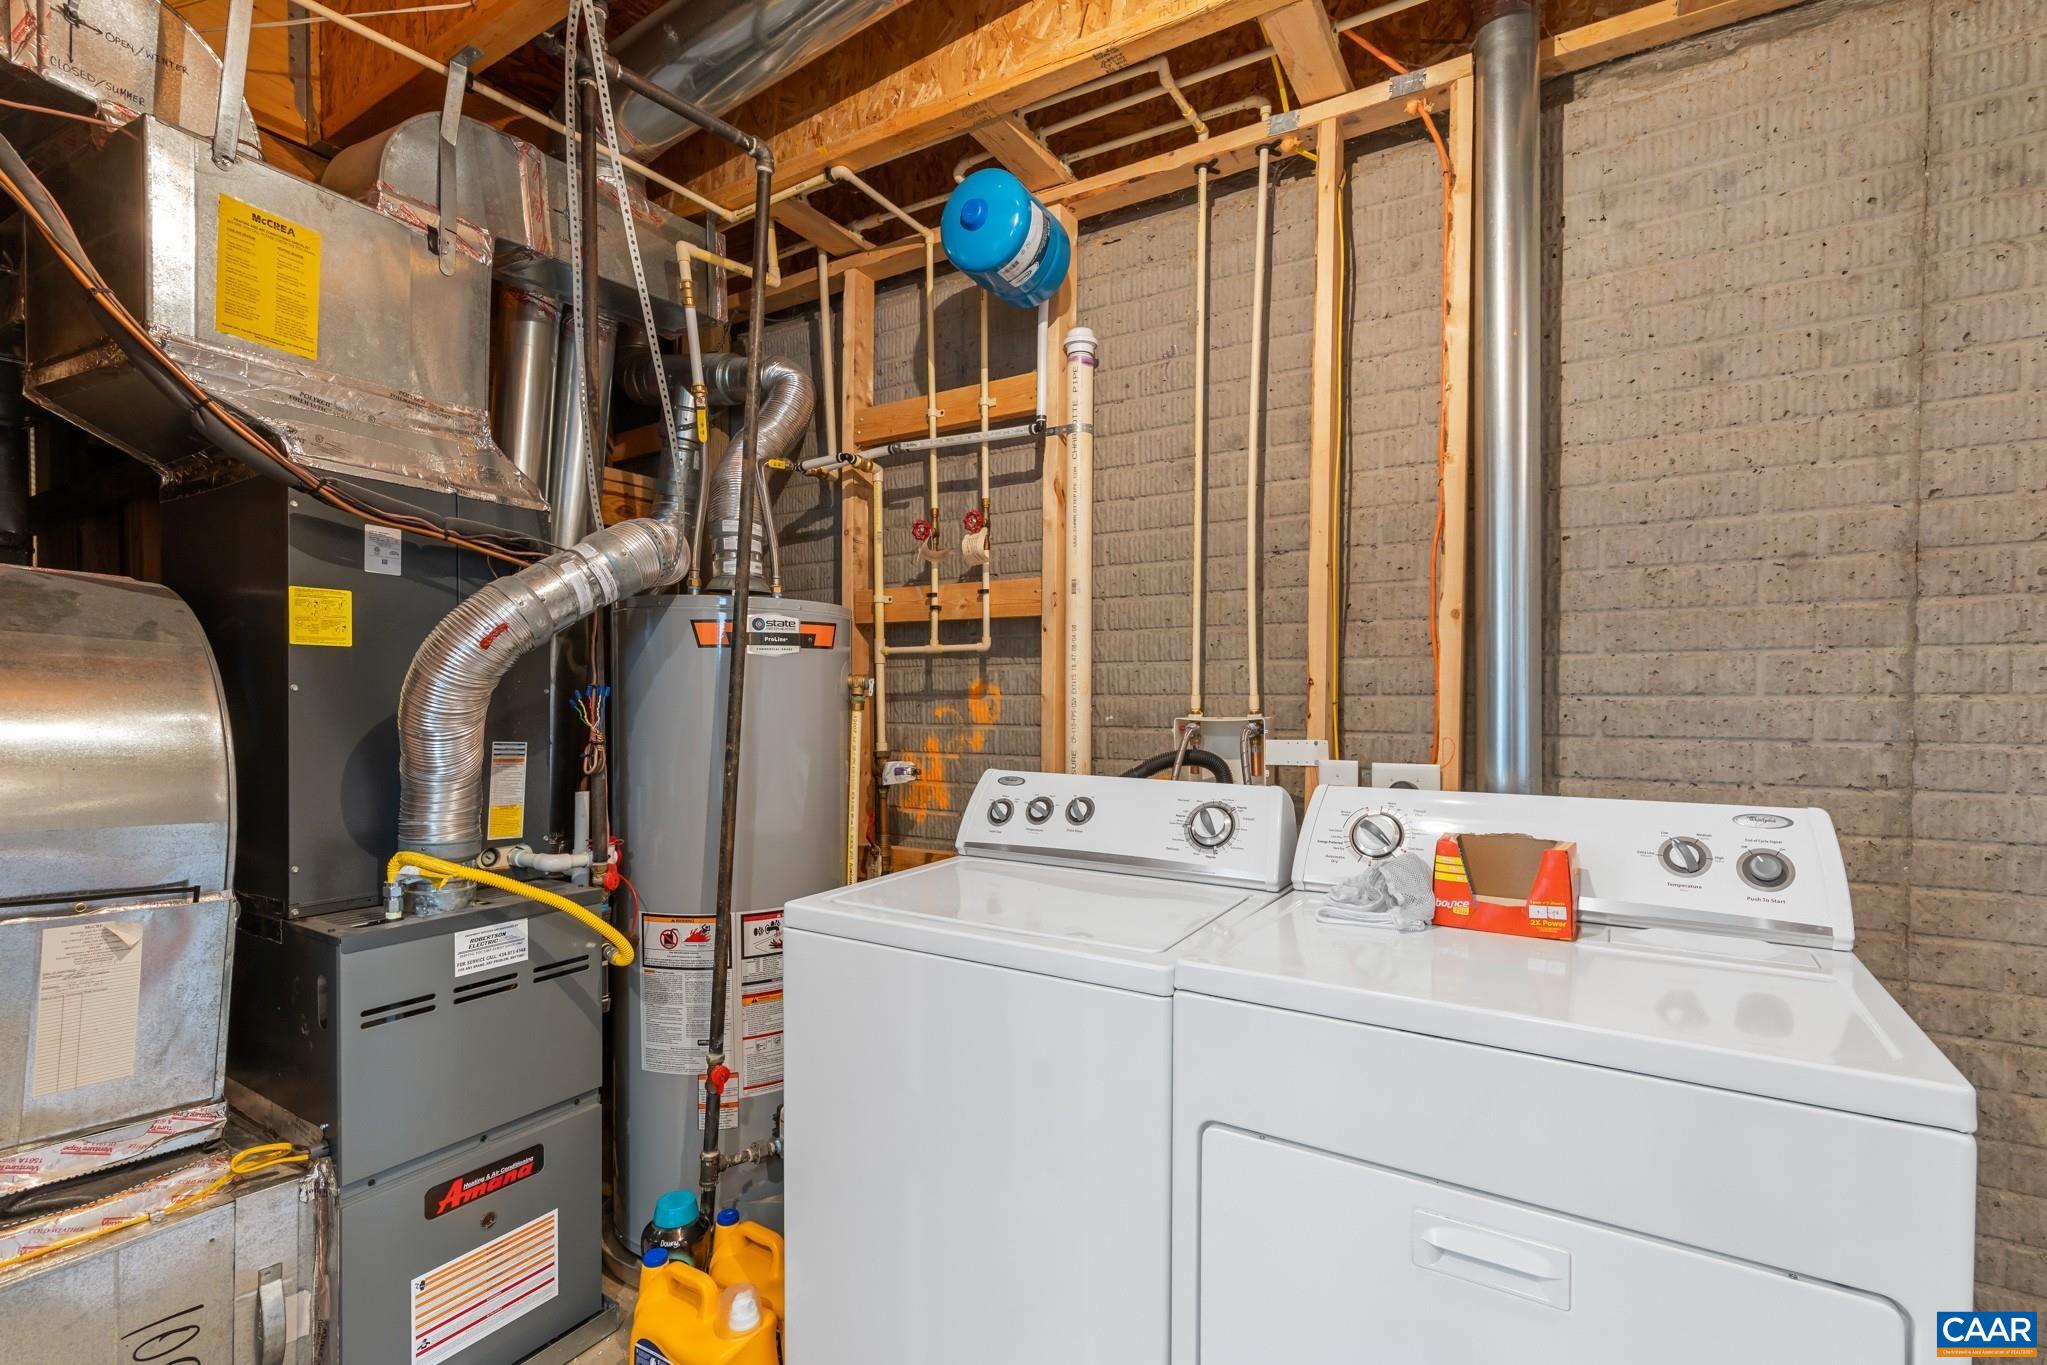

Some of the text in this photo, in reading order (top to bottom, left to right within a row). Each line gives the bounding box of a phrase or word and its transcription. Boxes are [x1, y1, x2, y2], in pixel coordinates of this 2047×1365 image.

[105, 31, 190, 76] OPEN/WINTER
[50, 56, 146, 107] CLOSED/SUMMER
[252, 213, 296, 237] McCREA
[1071, 400, 1079, 460] CHAROTTE
[766, 620, 796, 628] state
[1435, 897, 1470, 908] bounce
[468, 939, 499, 949] ELECTRIC
[470, 931, 507, 943] ROBERTSON
[9, 1164, 40, 1173] Venture
[463, 1176, 485, 1190] Heating
[501, 1156, 534, 1173] Conditioning
[436, 1162, 535, 1215] Amana
[660, 1240, 680, 1248] Downy
